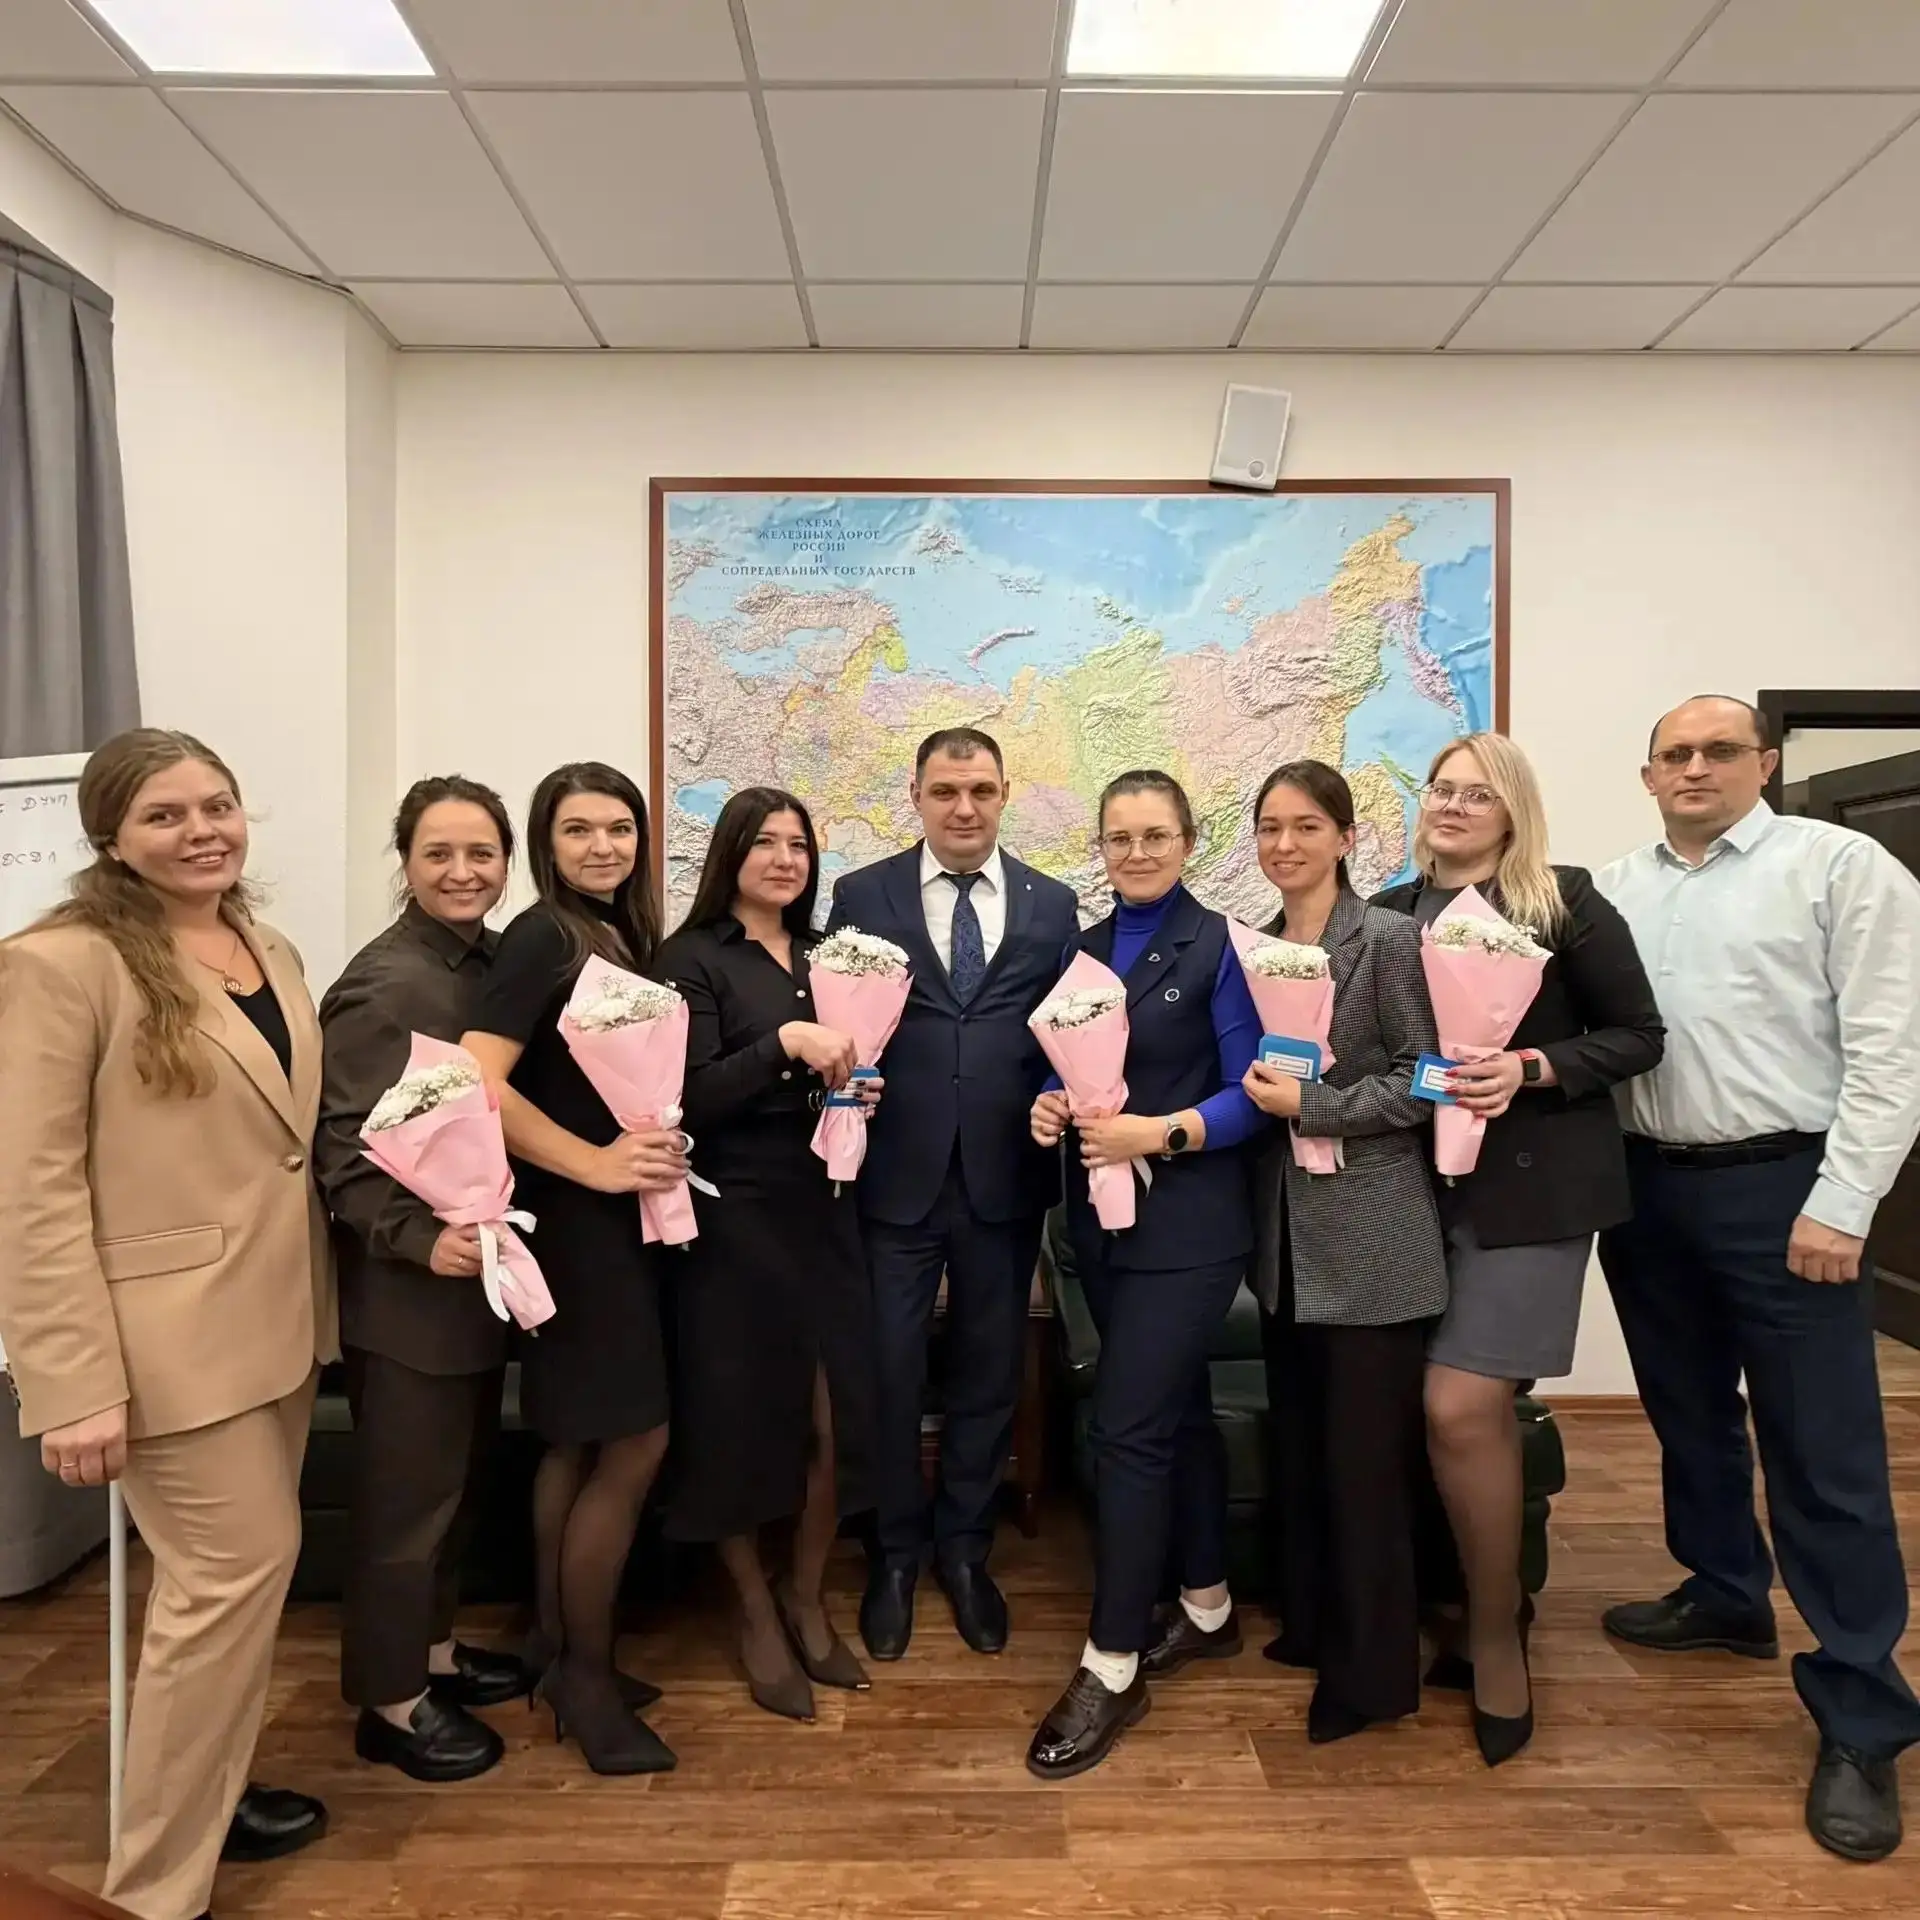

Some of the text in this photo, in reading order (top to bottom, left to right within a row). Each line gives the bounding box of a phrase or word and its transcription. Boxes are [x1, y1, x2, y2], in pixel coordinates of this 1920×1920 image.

[795, 518, 842, 528] СХЕМА
[758, 530, 880, 541] ЖЕЛЕЗНЫХ ДОРОГ
[792, 542, 846, 552] РОССИИ
[814, 554, 824, 564] И
[721, 566, 916, 577] СОПРЕДЕЛЬНЫХ ГОСУДАРСТВ
